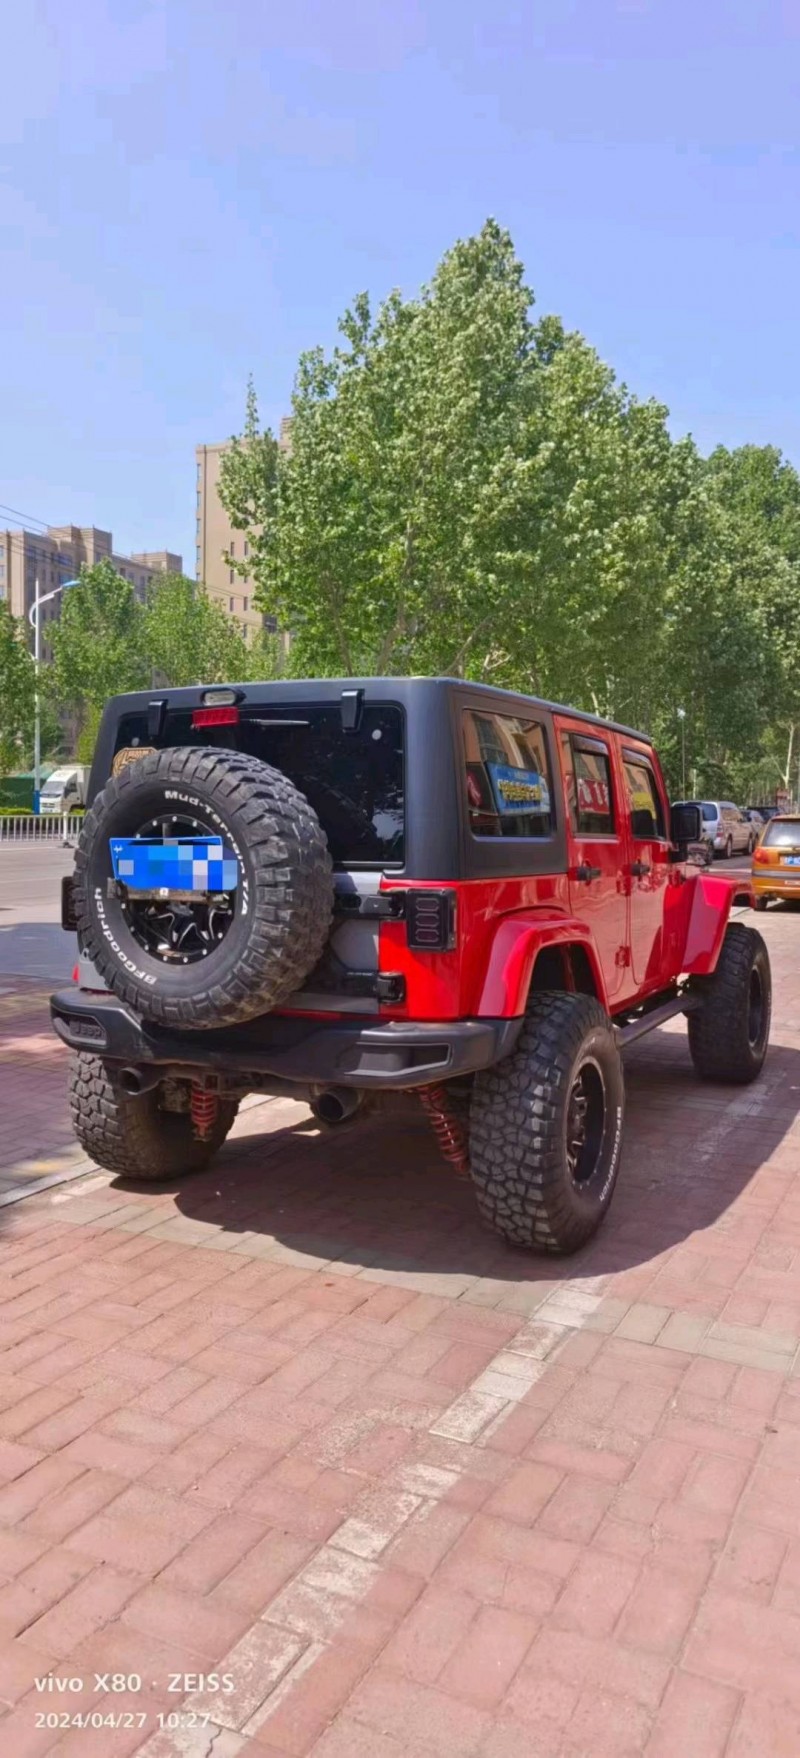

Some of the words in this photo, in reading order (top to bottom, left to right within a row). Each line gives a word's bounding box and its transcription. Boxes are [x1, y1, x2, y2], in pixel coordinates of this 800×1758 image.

[164, 790, 246, 874] Mud-Terrain
[241, 879, 249, 915] T/A
[94, 887, 157, 985] BFGoodrich
[599, 1106, 622, 1201] BFGoodrich
